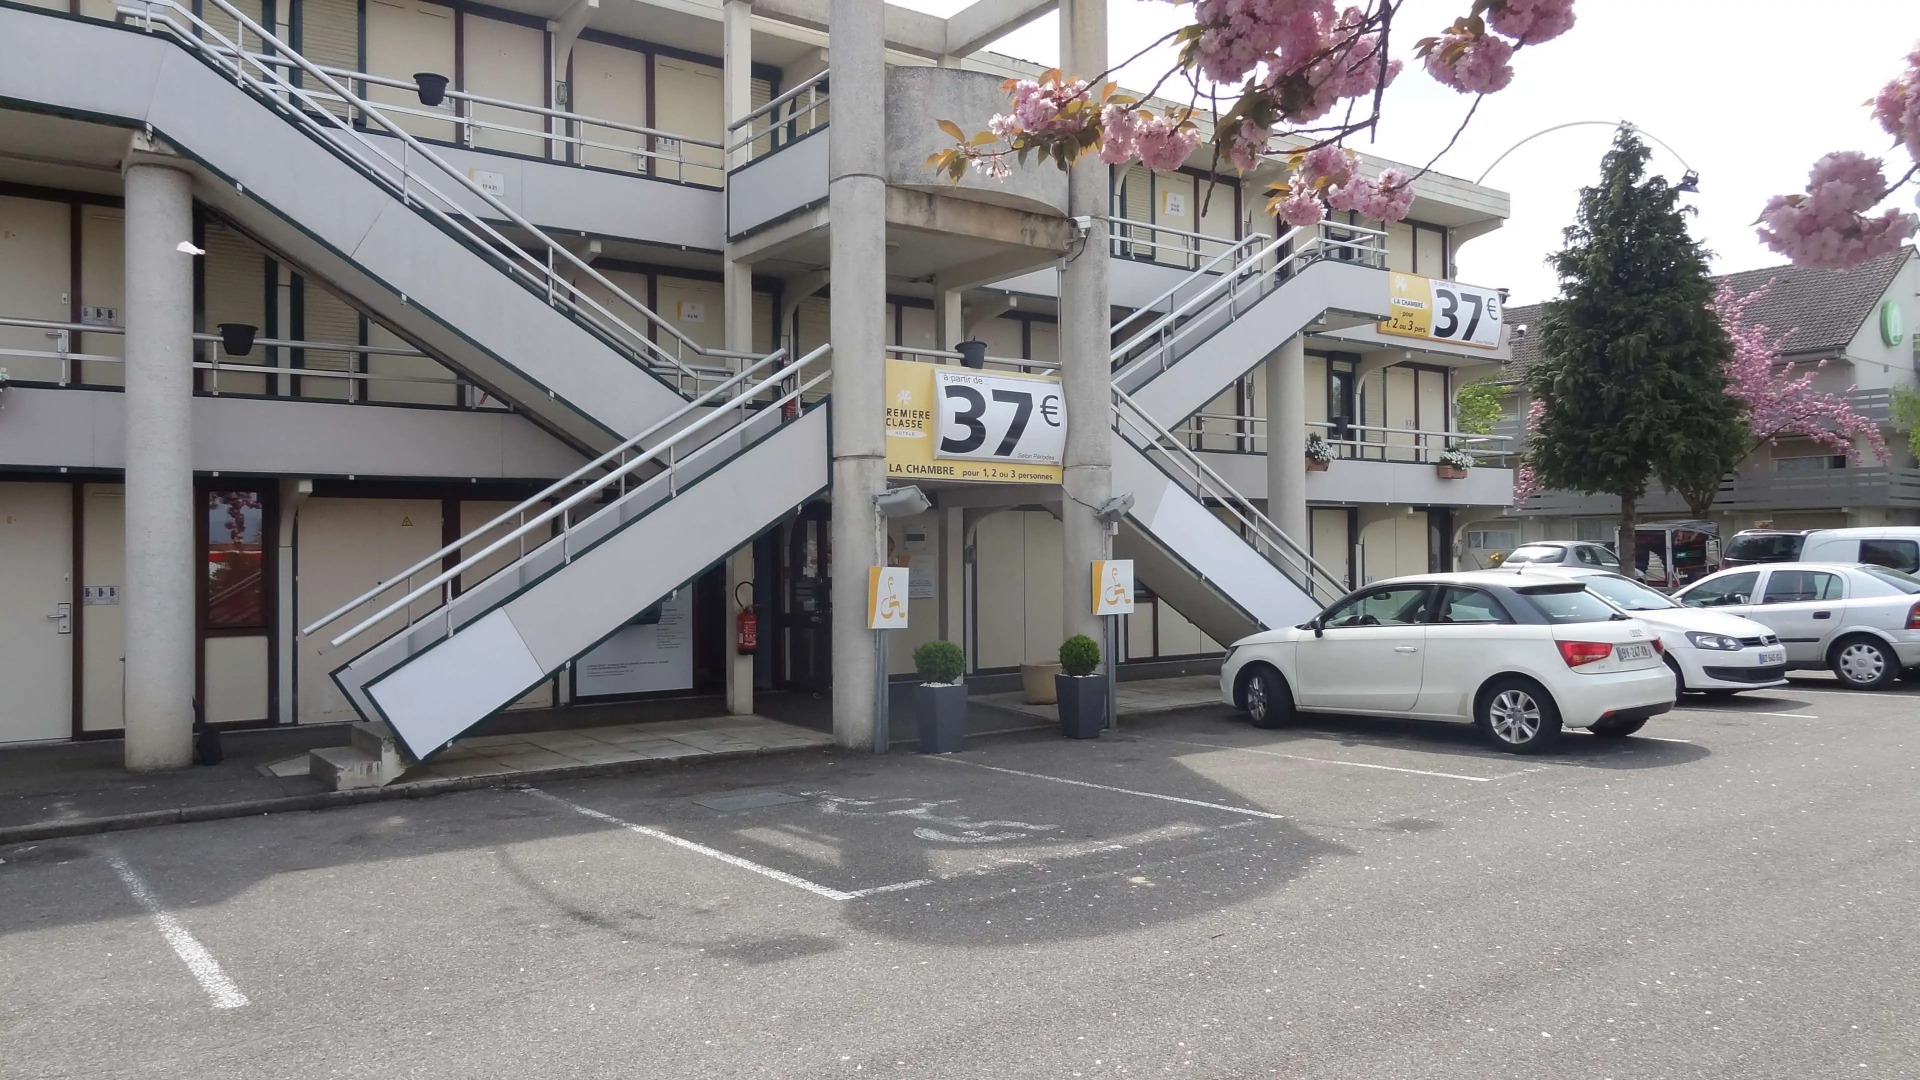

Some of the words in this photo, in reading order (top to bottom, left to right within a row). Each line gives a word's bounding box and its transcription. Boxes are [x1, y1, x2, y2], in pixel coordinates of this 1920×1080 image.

[1401, 299, 1424, 308] CHAMBRE
[1392, 318, 1398, 329] 2
[1407, 320, 1413, 331] 3
[943, 373, 949, 381] à
[950, 375, 971, 384] partir
[972, 376, 983, 385] de
[886, 407, 931, 420] REMIERE
[886, 418, 923, 428] CLASSE
[889, 463, 903, 473] LA
[906, 464, 955, 475] CHAMBRE
[991, 468, 997, 478] 2
[1010, 469, 1016, 478] 3
[1018, 473, 1053, 481] personnes
